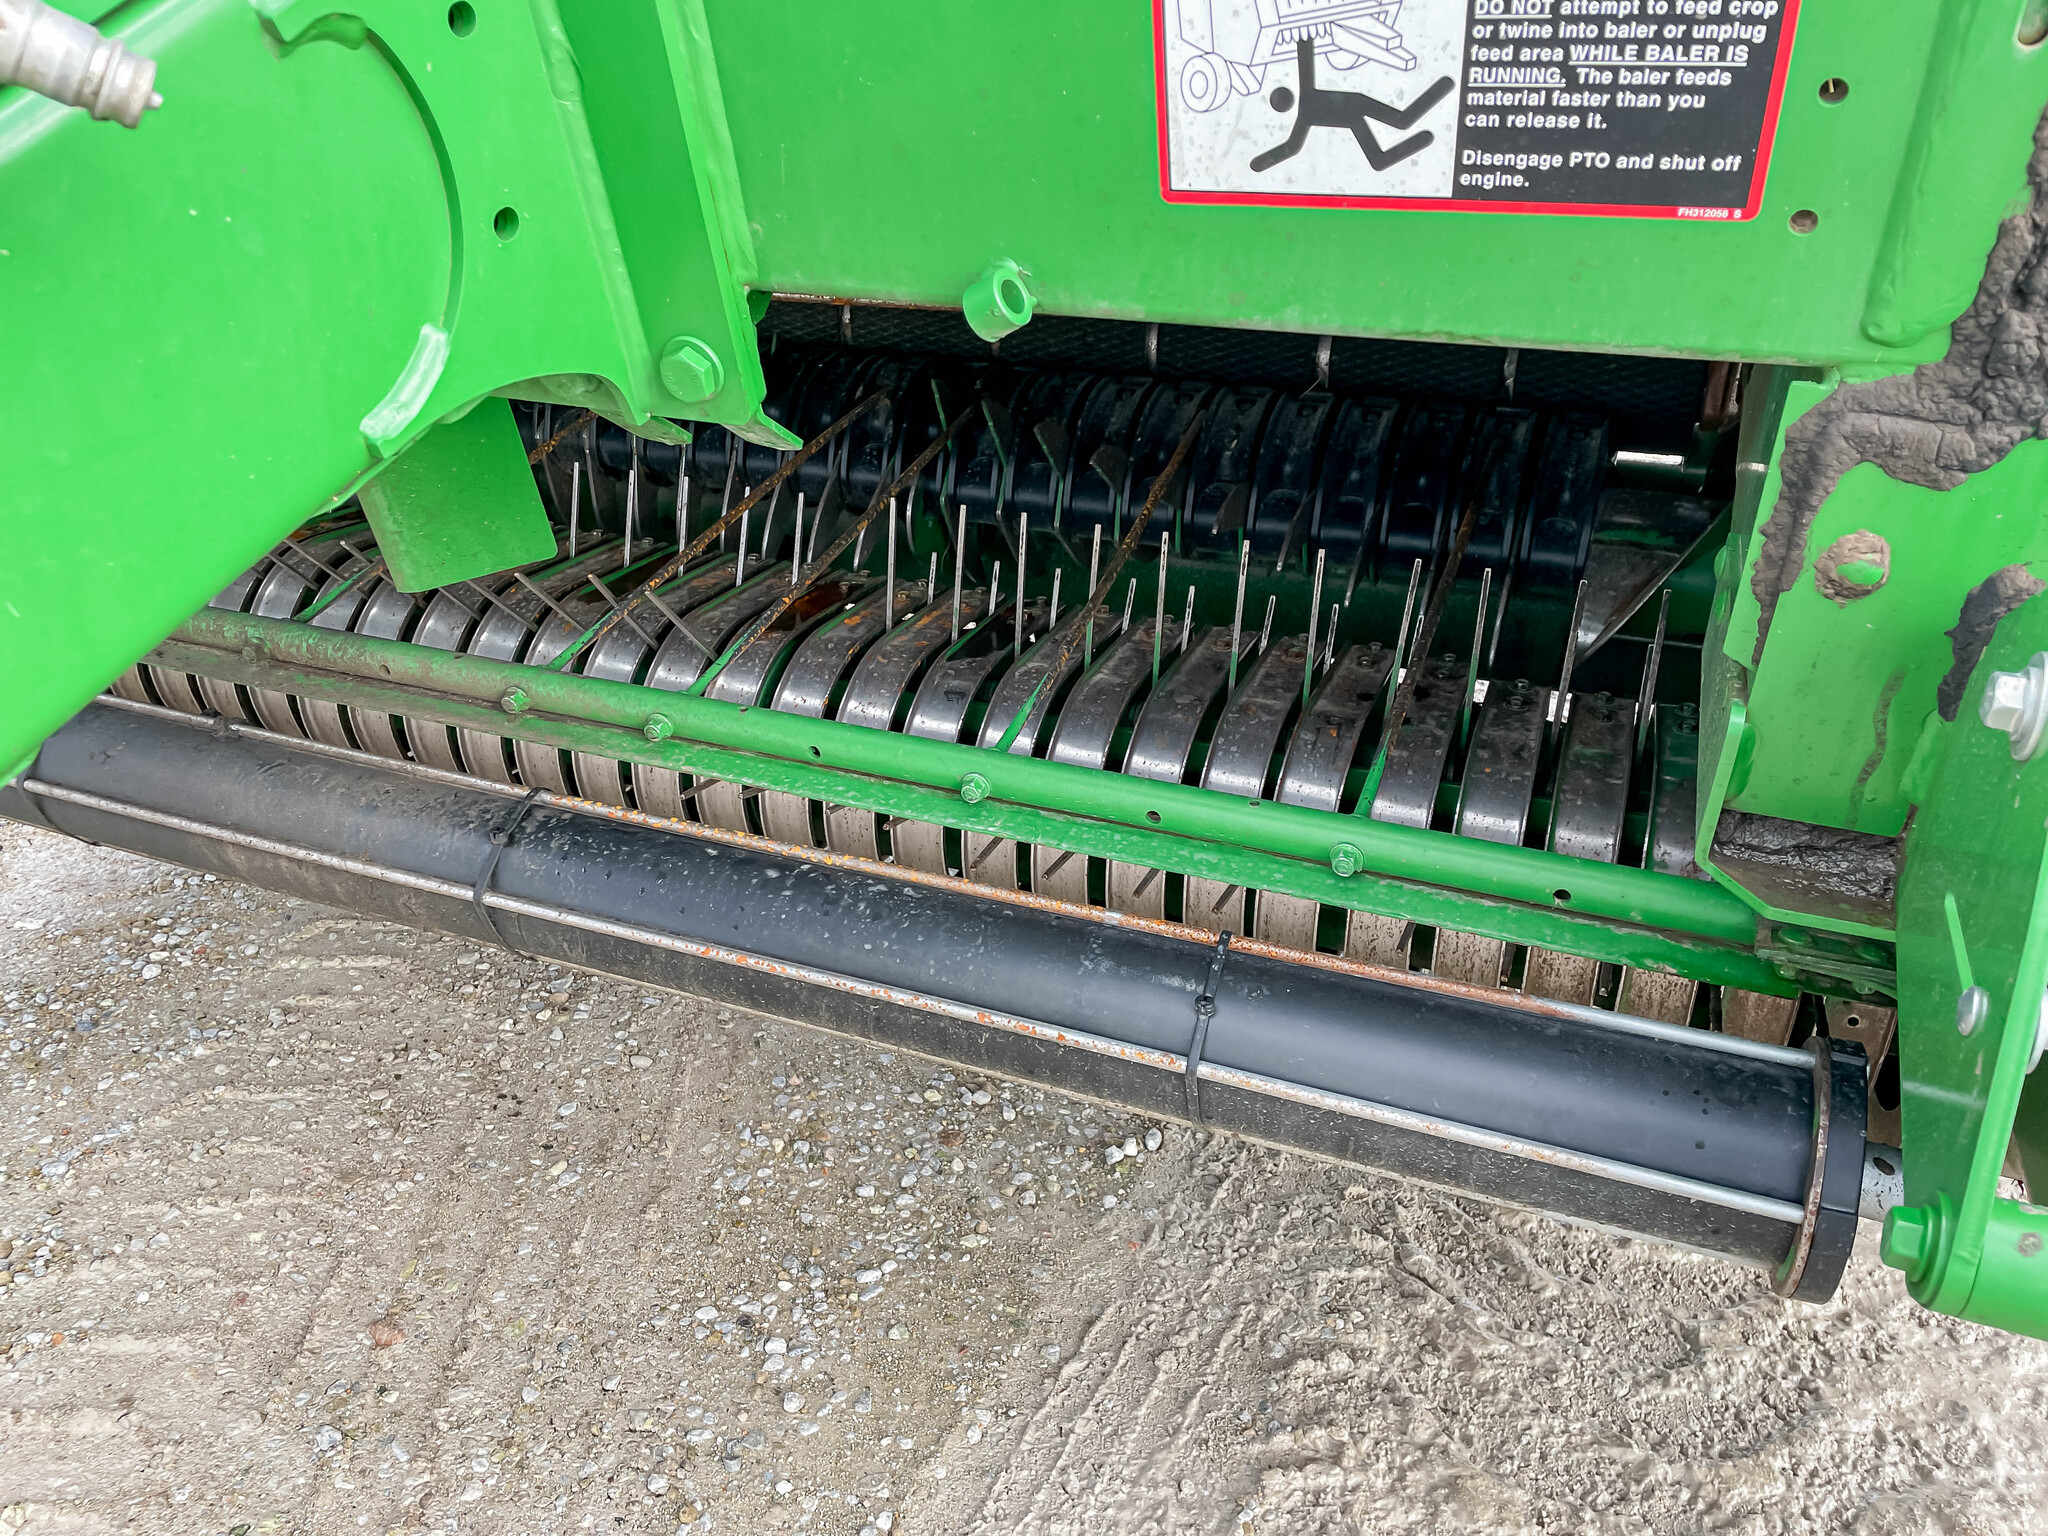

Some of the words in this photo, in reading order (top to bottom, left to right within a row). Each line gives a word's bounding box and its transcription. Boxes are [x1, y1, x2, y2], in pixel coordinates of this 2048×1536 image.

[1475, 0, 1504, 15] DO
[1511, 0, 1553, 15] NOT
[1560, 0, 1640, 18] attempt
[1647, 0, 1668, 15] to
[1676, 0, 1722, 15] feed
[1729, 1, 1778, 19] crop
[1472, 25, 1494, 39] or
[1499, 22, 1553, 39] twine
[1559, 21, 1598, 38] into
[1604, 21, 1658, 38] baler
[1663, 24, 1686, 38] or
[1692, 21, 1767, 43] unplug
[1471, 45, 1513, 61] feed
[1519, 48, 1563, 61] area
[1569, 44, 1639, 62] WHILE
[1644, 45, 1720, 62] BALER
[1726, 46, 1749, 62] IS
[1468, 67, 1566, 83] RUNNING.
[1576, 68, 1613, 84] The
[1619, 68, 1670, 85] baler
[1676, 68, 1732, 86] feeds
[1467, 90, 1545, 106] material
[1552, 90, 1611, 107] faster
[1616, 91, 1661, 107] than
[1668, 94, 1705, 111] you
[1465, 114, 1499, 127] can
[1507, 112, 1580, 128] release
[1587, 113, 1607, 129] it.
[1462, 150, 1563, 170] Disengage
[1569, 152, 1610, 168] PTO
[1616, 154, 1654, 169] and
[1659, 154, 1706, 170] shut
[1711, 155, 1742, 171] off
[1460, 171, 1529, 189] engine.
[1678, 208, 1729, 218] FH312056
[1734, 209, 1742, 218] S
